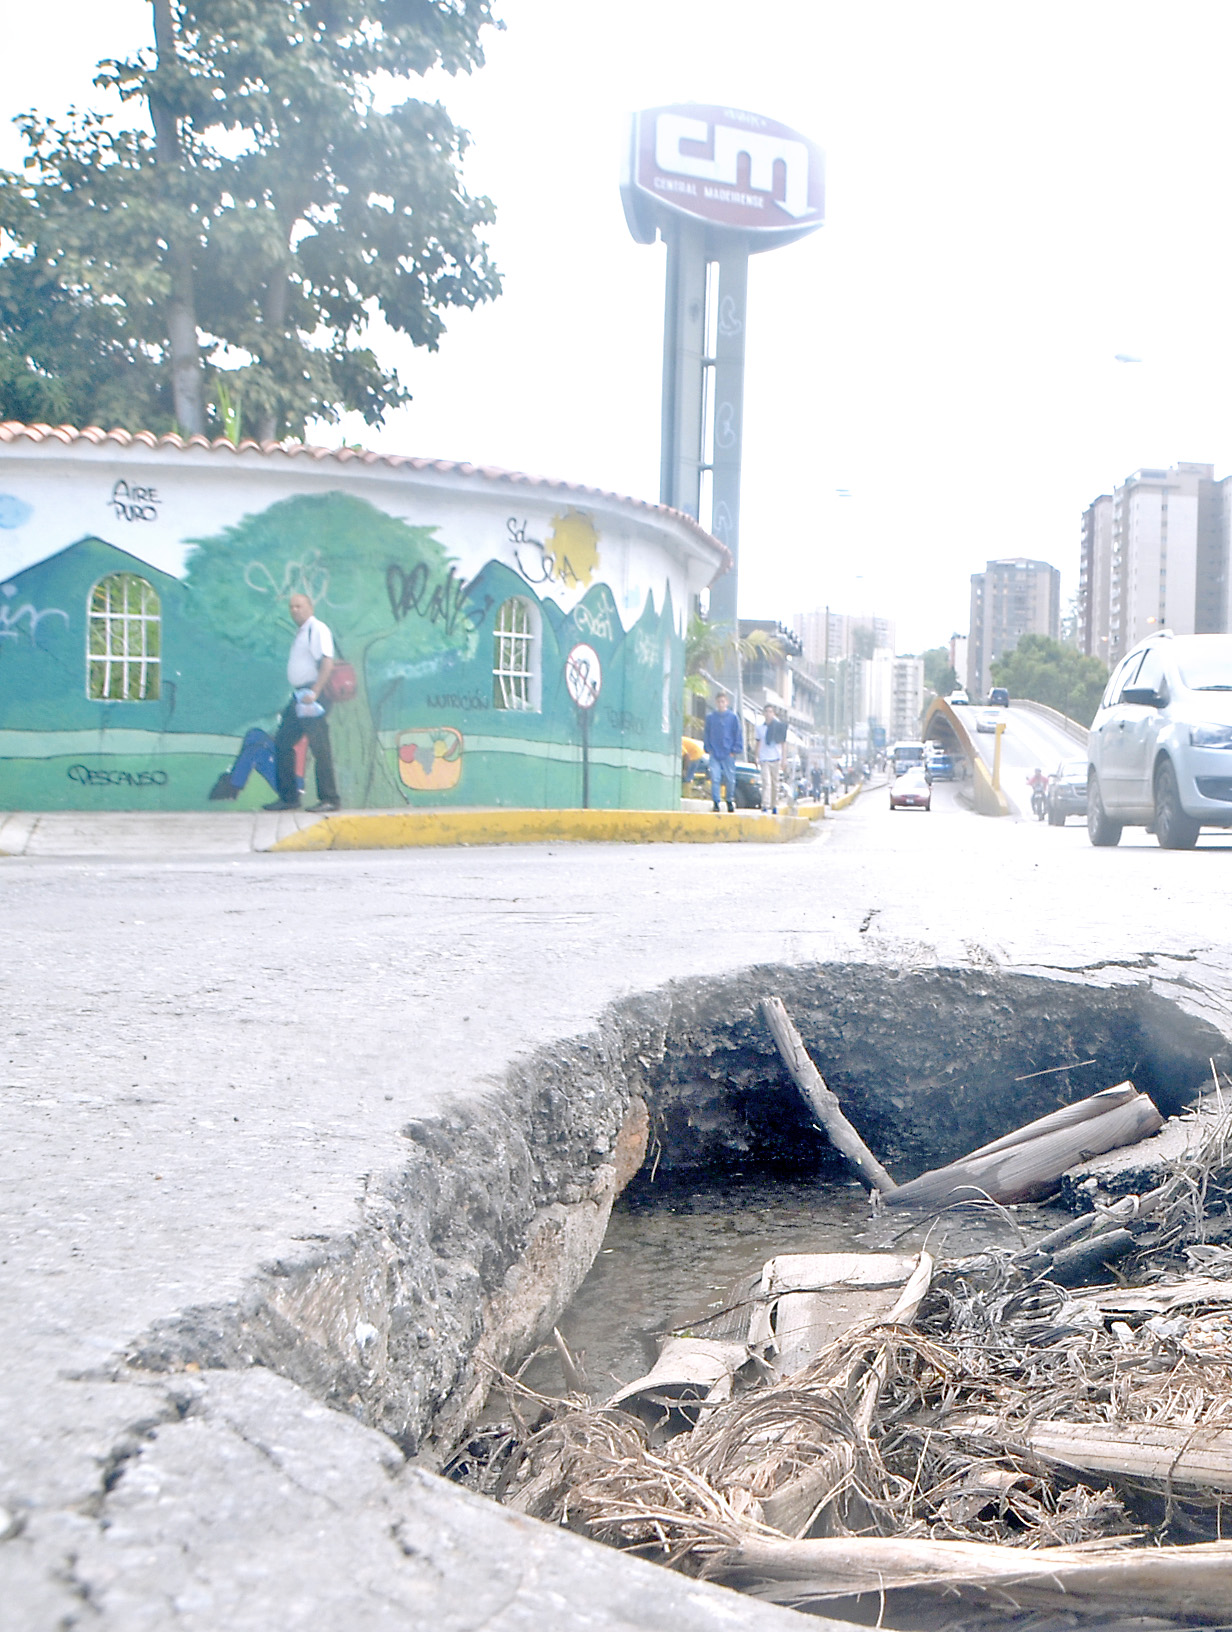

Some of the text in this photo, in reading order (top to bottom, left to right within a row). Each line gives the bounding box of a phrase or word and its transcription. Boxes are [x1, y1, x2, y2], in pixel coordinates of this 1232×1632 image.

[653, 176, 765, 209] CENTRAL MADEIRENSE
[112, 479, 163, 503] AIRE
[107, 500, 159, 522] PURO
